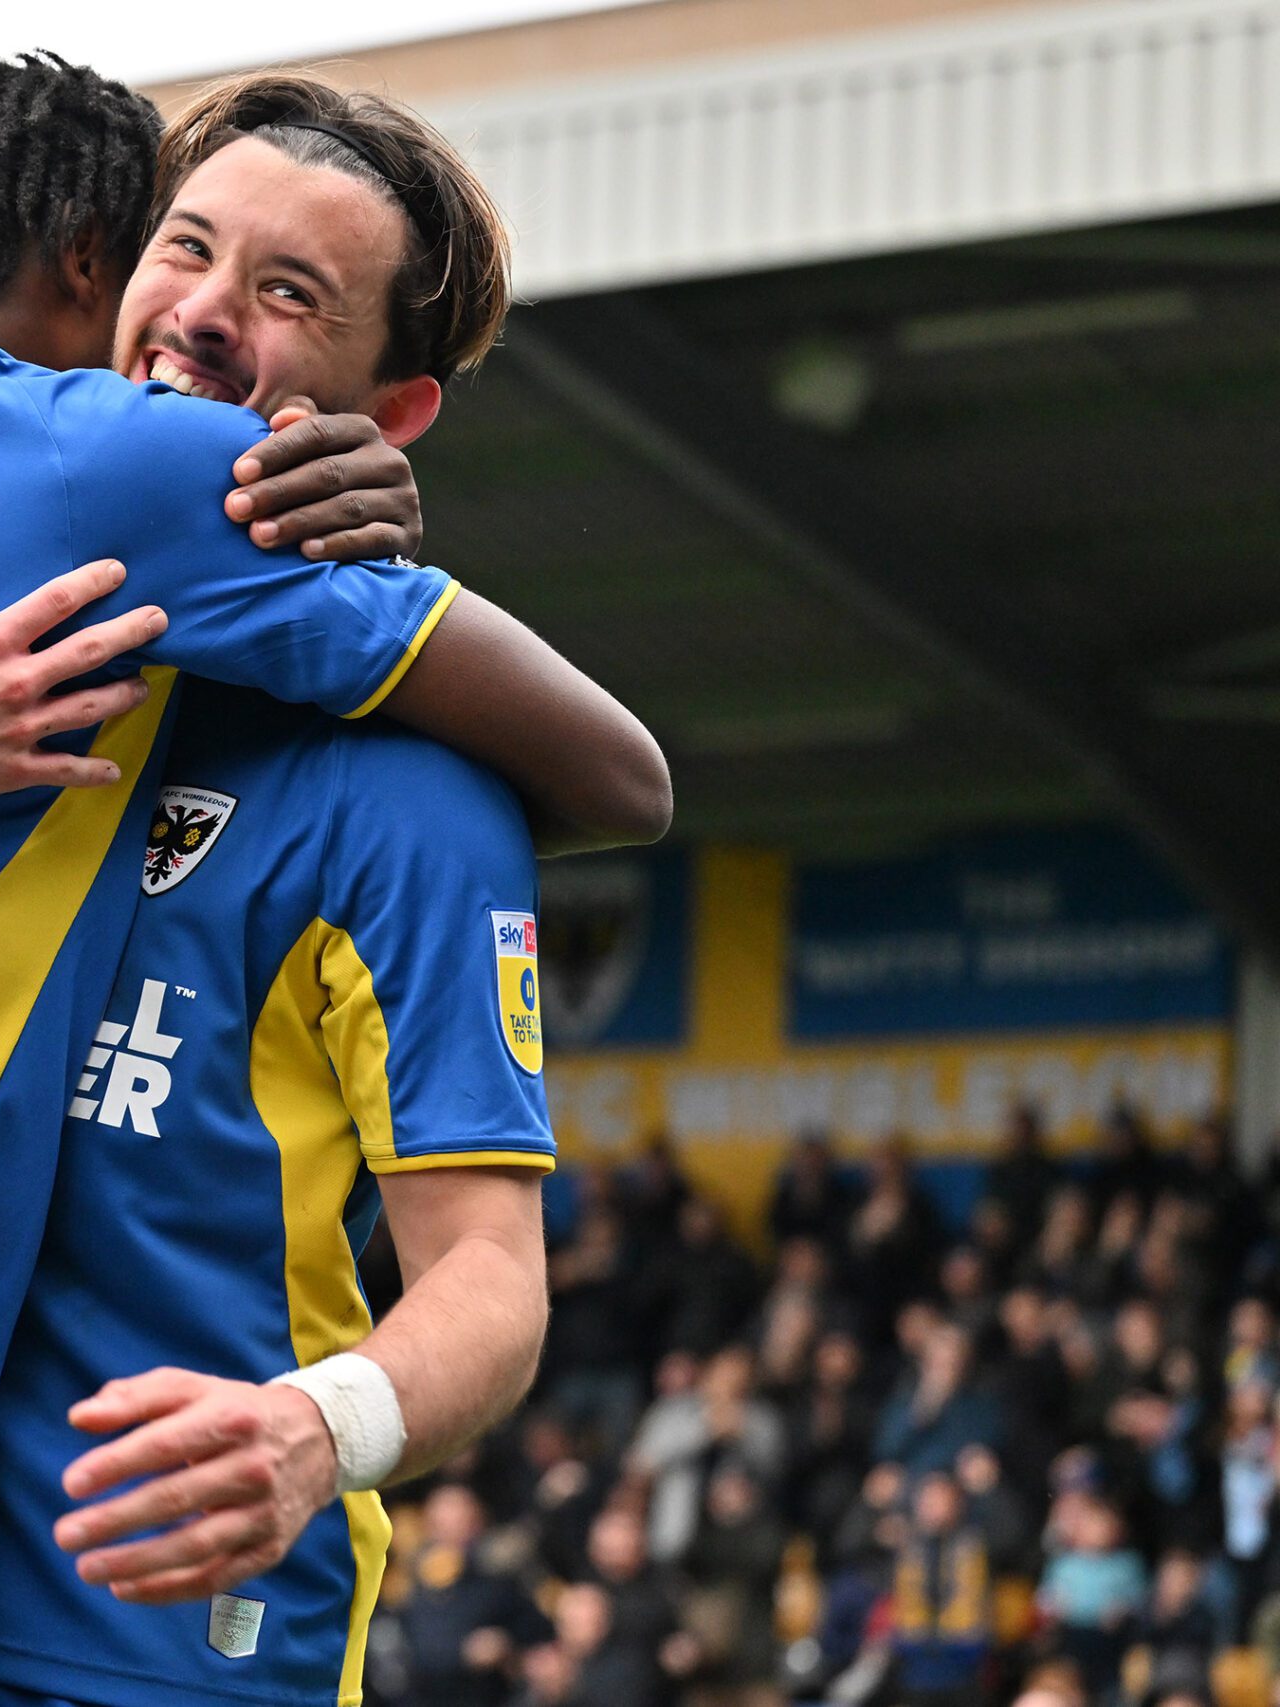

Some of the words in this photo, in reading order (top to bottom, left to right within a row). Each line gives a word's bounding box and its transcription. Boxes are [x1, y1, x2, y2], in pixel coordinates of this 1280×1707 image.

[163, 790, 181, 798] AFC
[181, 792, 230, 809] WIMBLEDON
[499, 922, 523, 949] sky
[510, 1014, 532, 1029] TAKE
[514, 1029, 526, 1043] TO
